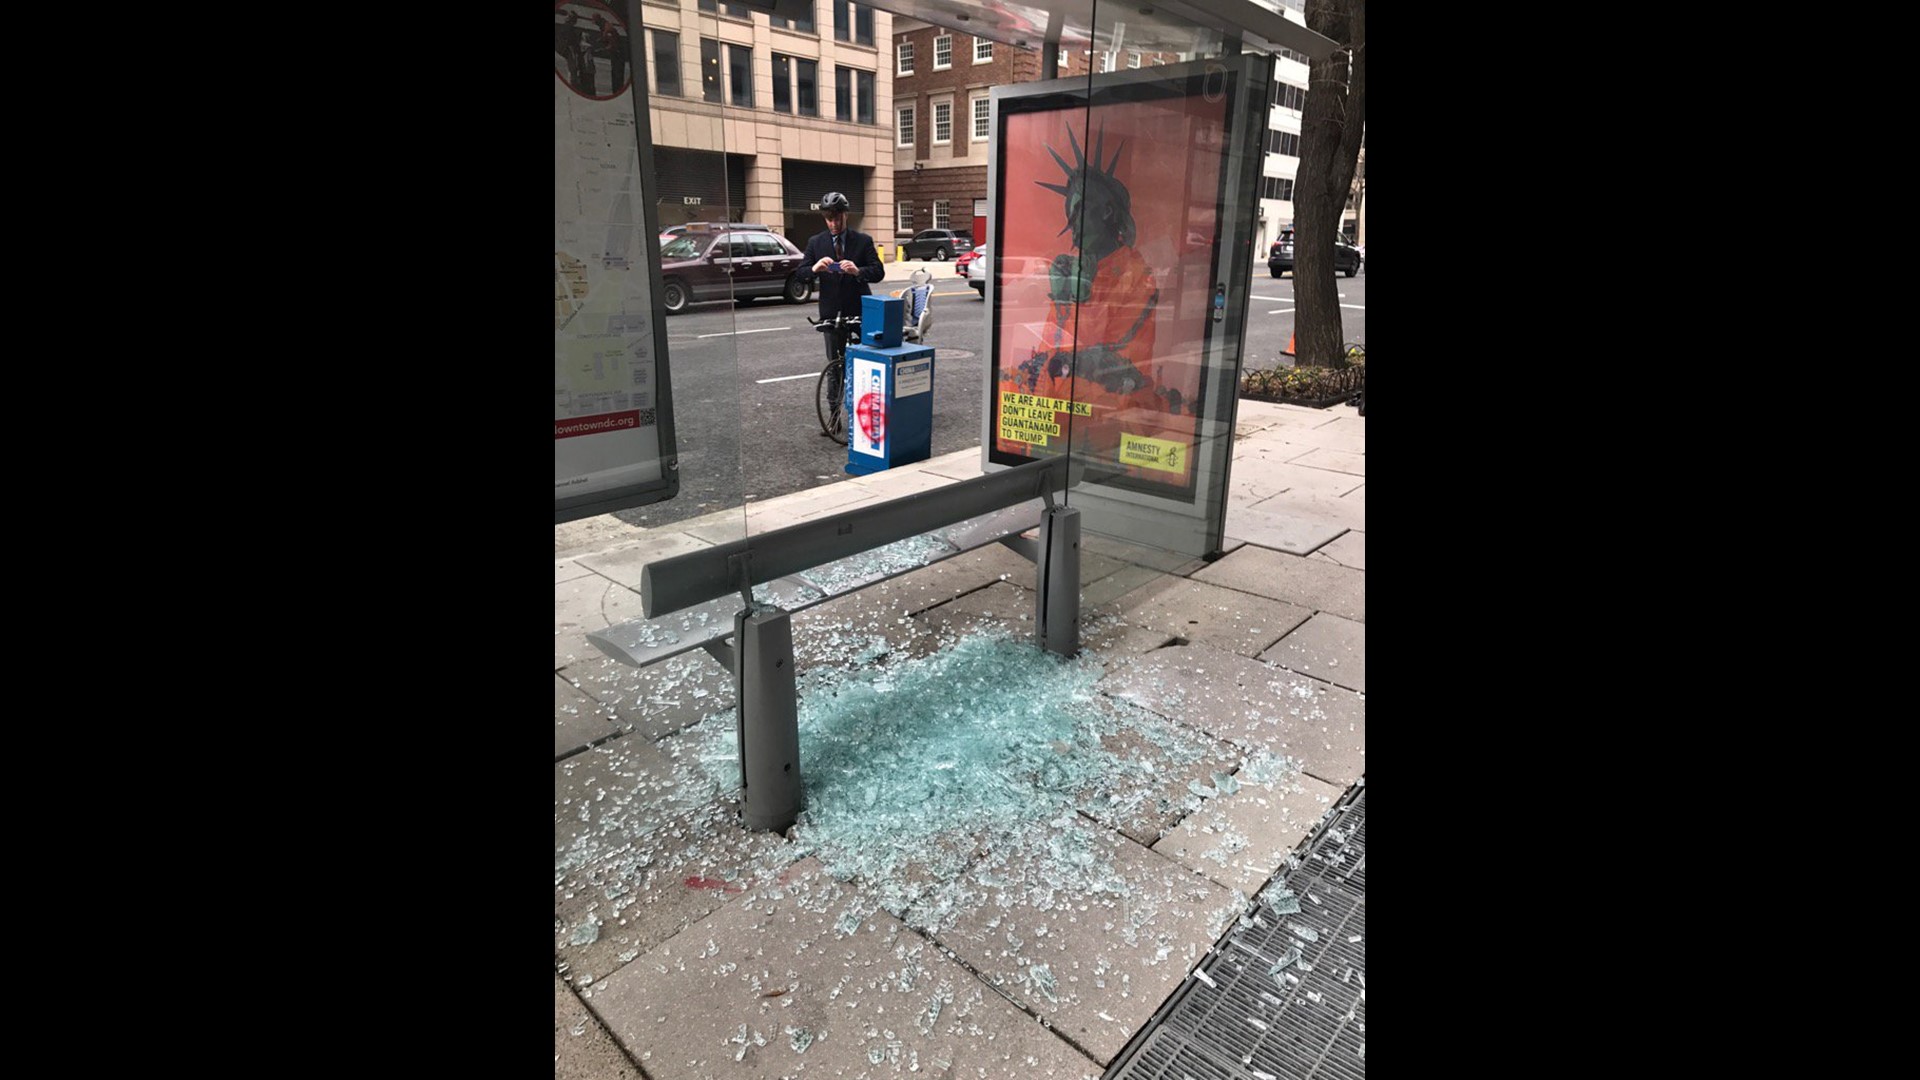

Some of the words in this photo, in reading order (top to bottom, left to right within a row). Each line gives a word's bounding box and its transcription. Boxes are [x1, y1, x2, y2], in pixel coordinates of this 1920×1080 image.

[683, 196, 702, 205] EXIT
[810, 202, 822, 211] EN
[1003, 392, 1016, 404] WE
[1018, 394, 1034, 406] ARE
[1036, 397, 1051, 409] ALL
[1052, 399, 1064, 411] AT
[1065, 401, 1090, 415] RSK.
[1002, 404, 1026, 417] DON'T
[1028, 408, 1053, 422] LEAVE
[1002, 416, 1058, 435] GUANTANAMO
[1001, 428, 1012, 438] TO
[1015, 430, 1045, 445] TRUMP.
[1126, 441, 1160, 455] AMNESTY
